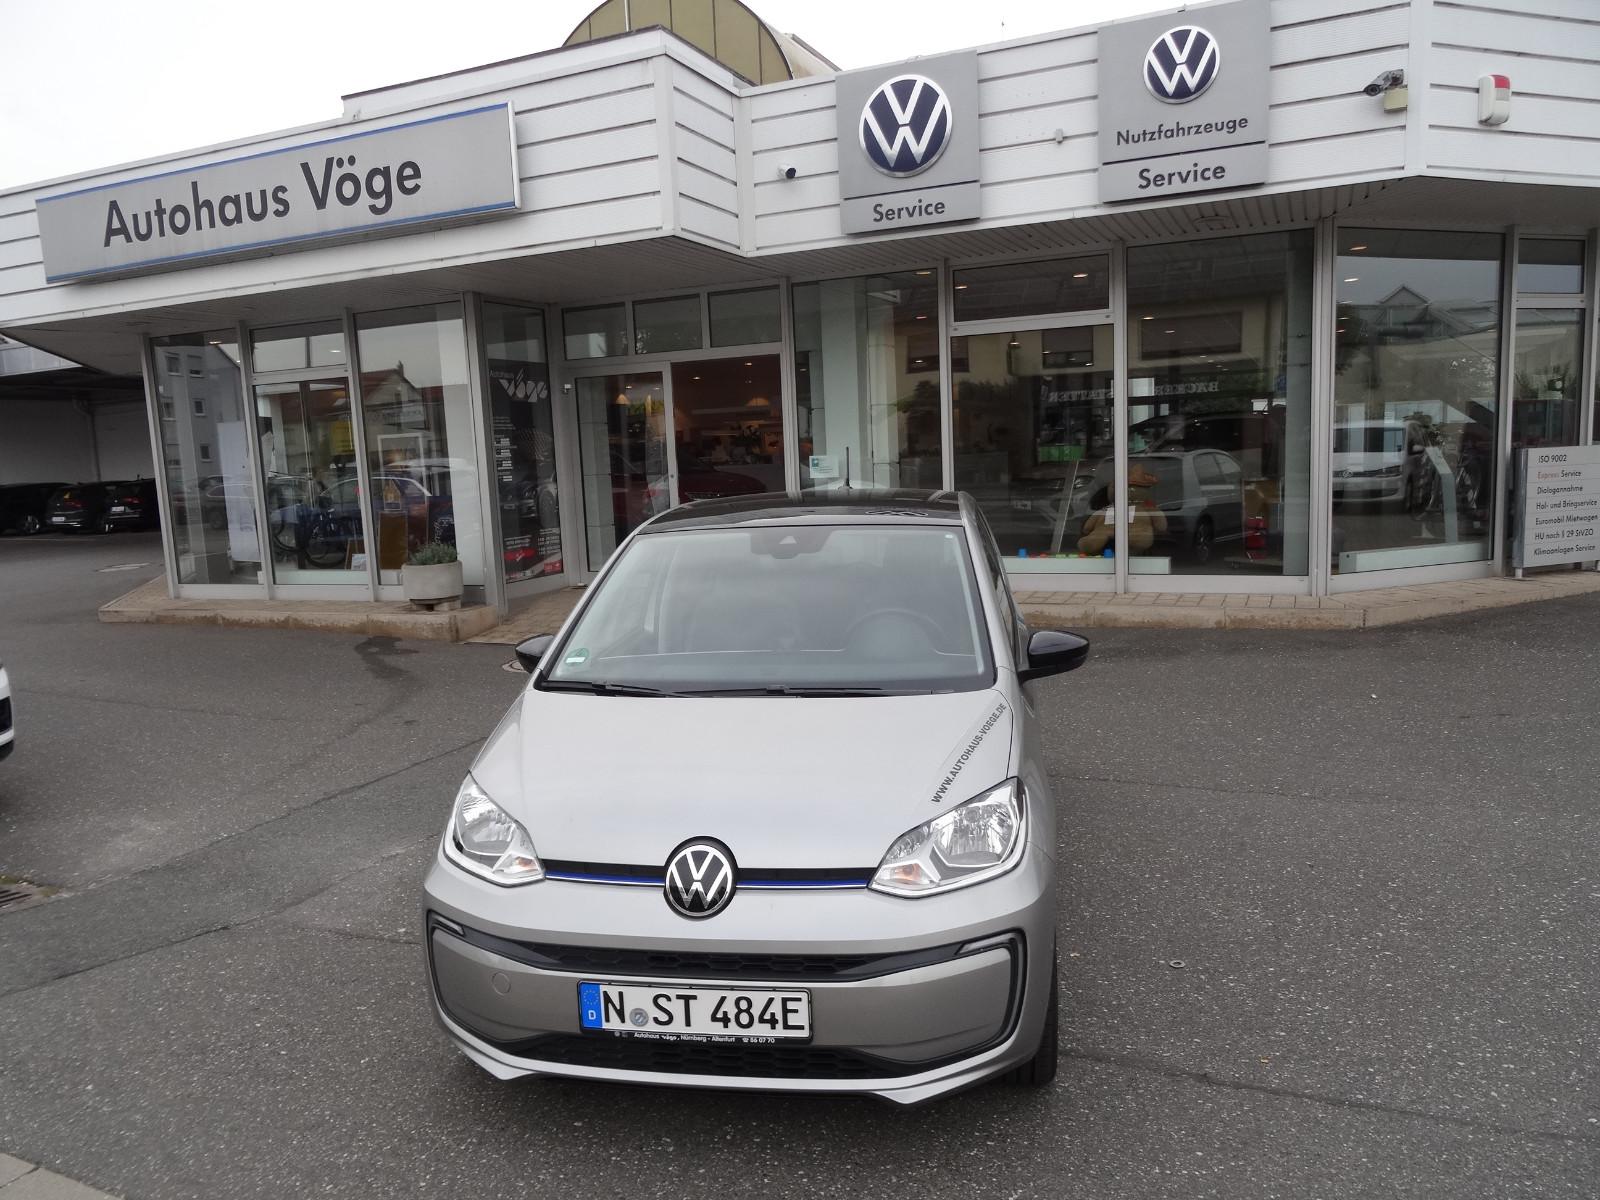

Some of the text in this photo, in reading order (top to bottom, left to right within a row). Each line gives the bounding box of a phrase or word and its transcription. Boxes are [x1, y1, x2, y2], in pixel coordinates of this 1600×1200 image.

[1116, 117, 1249, 146] Nutzfahrzeuge
[1138, 162, 1226, 190] Service
[103, 155, 422, 248] Autohaus Vöge
[873, 199, 945, 222] Service
[1538, 454, 1567, 463] ISO 9002
[1561, 470, 1581, 478] Service
[1537, 484, 1583, 496] Dialogannahme
[1536, 499, 1598, 511] Hol- und Bringservice
[1535, 514, 1598, 525] Euromobil Mietwagen
[1535, 532, 1545, 540] HU
[1545, 531, 1560, 540] nach
[1566, 530, 1574, 538] 29
[1575, 528, 1594, 537] StVZO
[1534, 544, 1596, 556] Klimaanlagen Service
[931, 703, 1007, 803] WWW.AUTOHAUS-VOEGE.DE
[587, 1010, 596, 1020] D
[602, 990, 805, 1031] N ST 484E
[680, 1034, 706, 1042] Nürnberg
